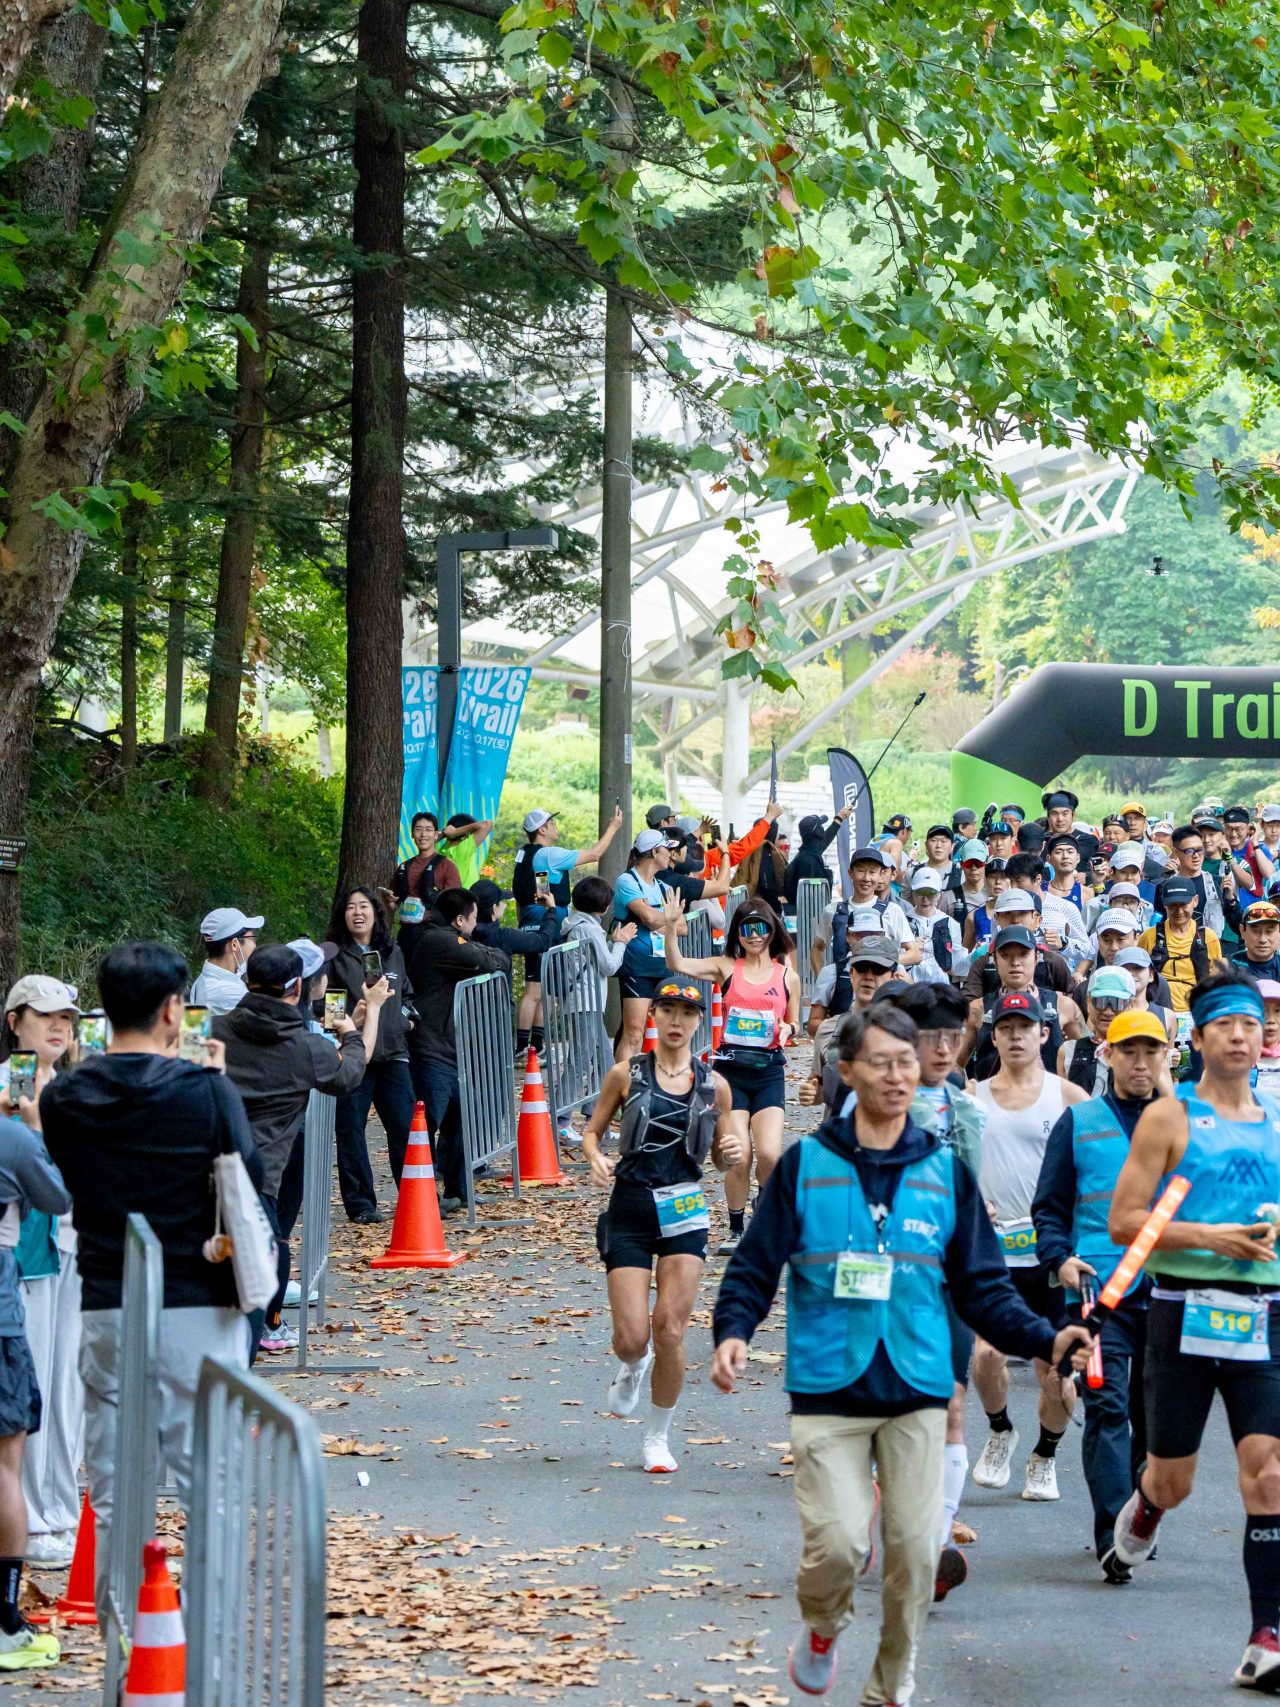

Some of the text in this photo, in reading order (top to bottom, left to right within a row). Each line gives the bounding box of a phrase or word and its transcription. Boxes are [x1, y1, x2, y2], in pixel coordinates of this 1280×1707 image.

[405, 670, 438, 704] 26
[1122, 679, 1158, 737] D
[1210, 1311, 1252, 1332] 516
